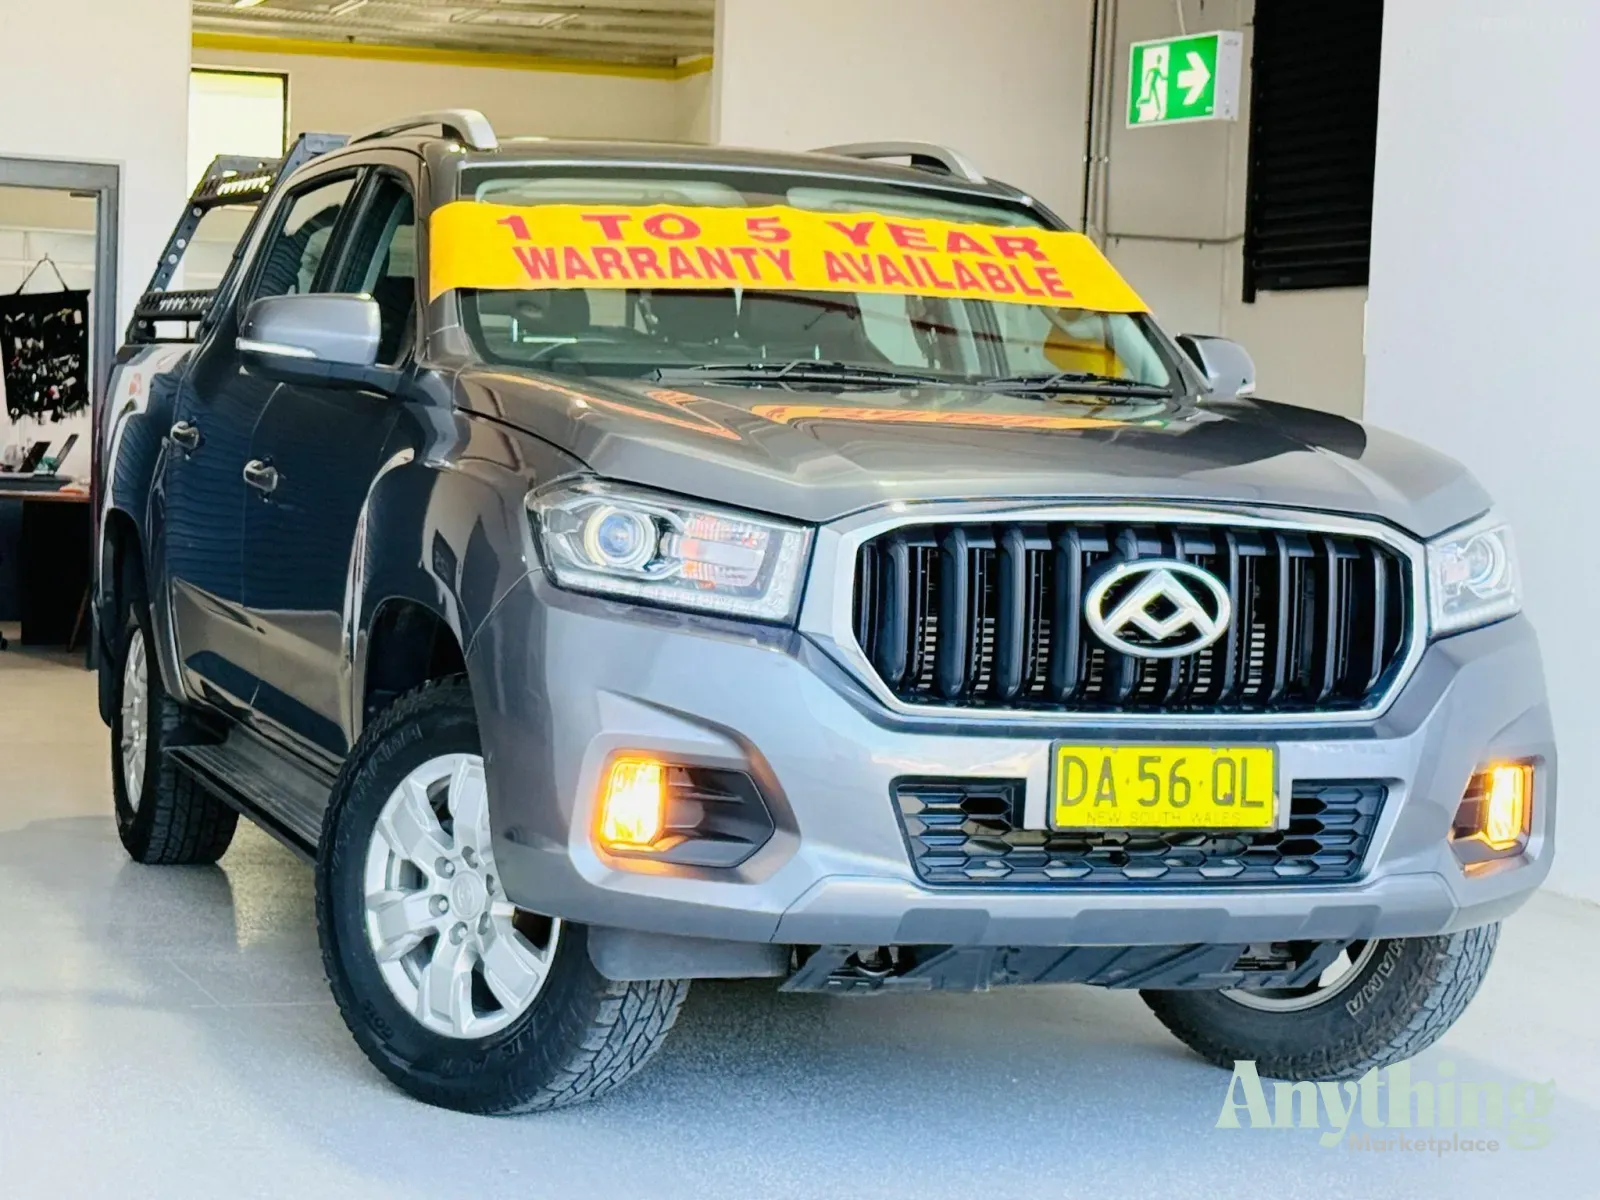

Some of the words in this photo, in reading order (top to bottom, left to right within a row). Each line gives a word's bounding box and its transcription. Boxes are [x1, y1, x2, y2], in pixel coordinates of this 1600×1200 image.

[497, 215, 531, 241] 1
[582, 213, 701, 241] TO
[746, 216, 791, 243] 5
[824, 221, 1049, 261] YEAR
[512, 246, 796, 281] WARRANTY
[824, 250, 1074, 298] AVAILABLE
[1061, 755, 1118, 808] DA
[1137, 755, 1191, 808] 56
[1212, 756, 1265, 808] QL
[1086, 811, 1121, 825] NEW
[1130, 811, 1181, 825] SOUTH
[1190, 811, 1242, 825] WALES
